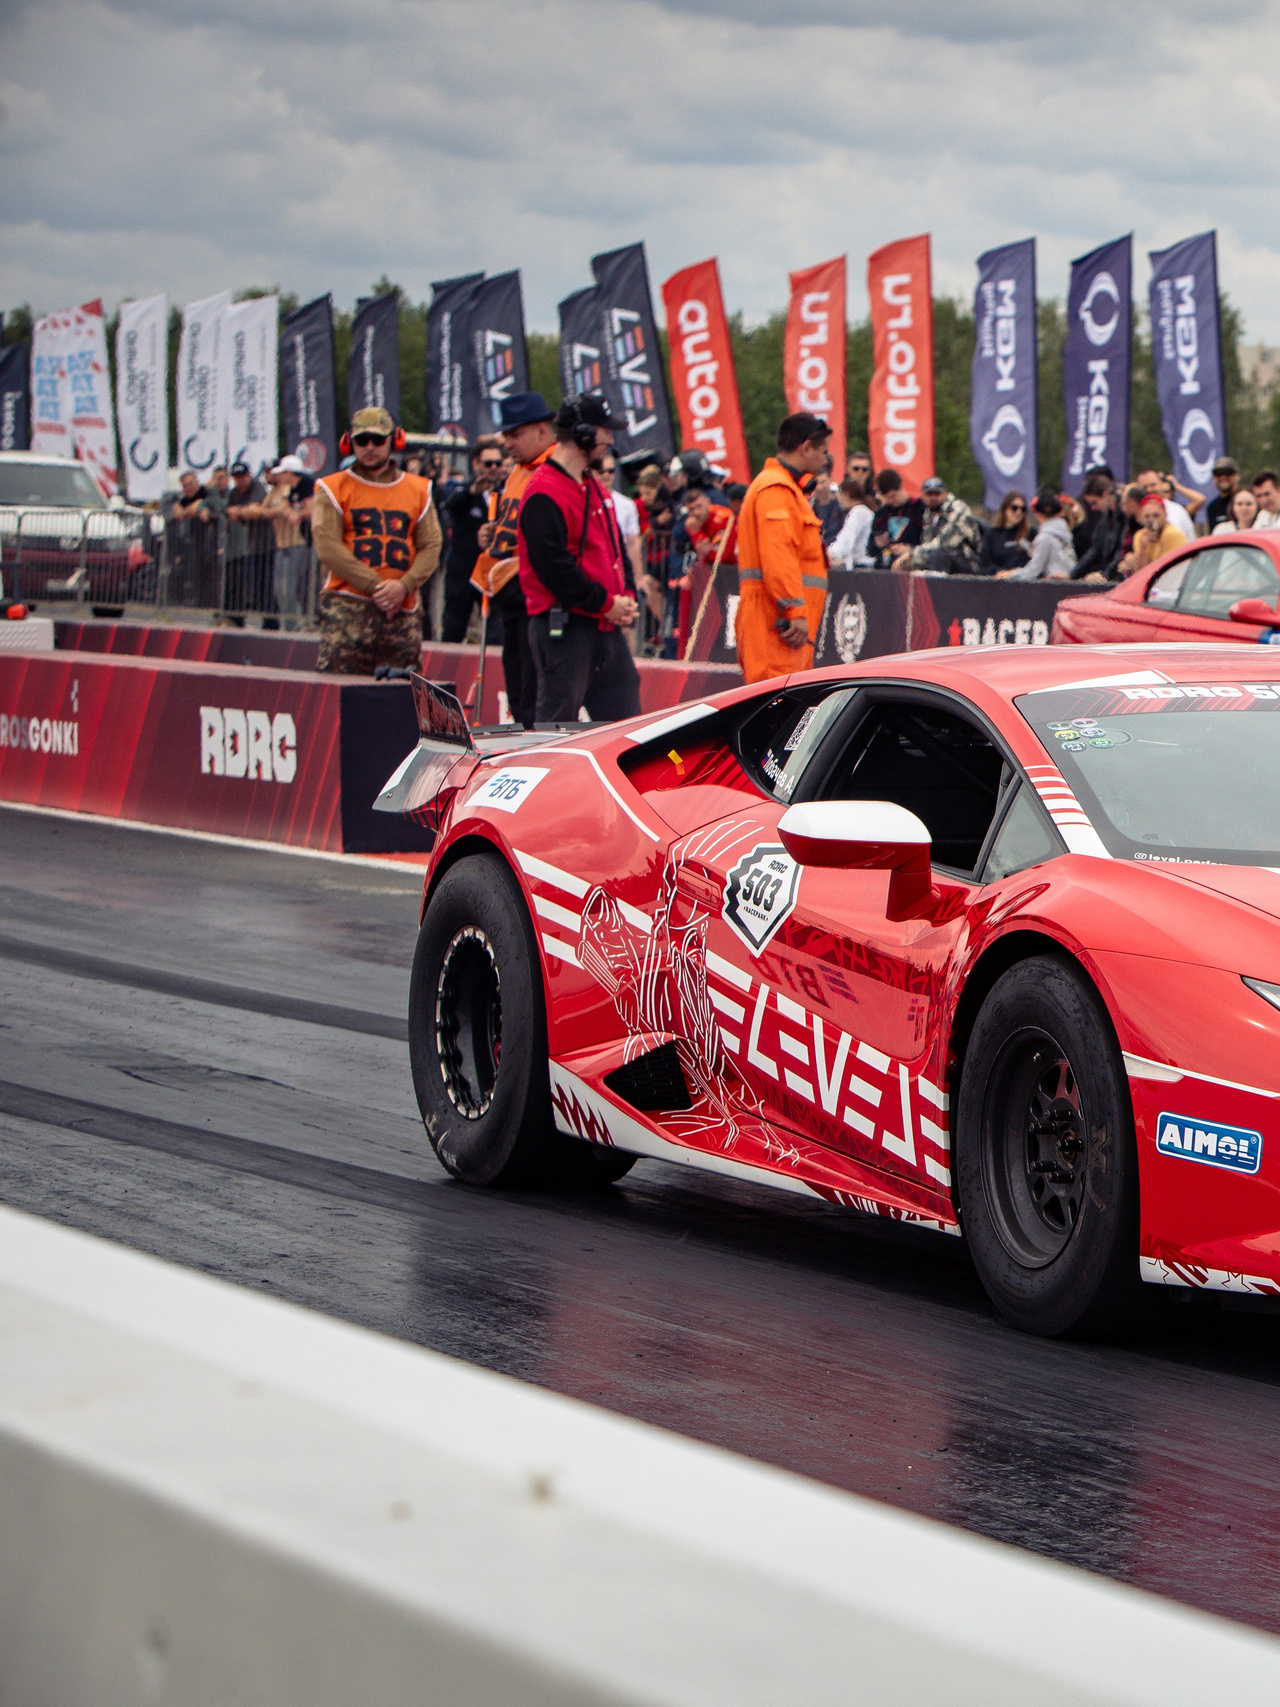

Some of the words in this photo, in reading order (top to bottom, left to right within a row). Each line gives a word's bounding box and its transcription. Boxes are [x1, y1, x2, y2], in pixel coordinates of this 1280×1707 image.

[1117, 686, 1243, 700] RDRC
[200, 706, 297, 784] RDRC
[488, 778, 528, 800] ВТБ
[767, 859, 789, 874] RDRC
[742, 868, 783, 913] 503
[745, 906, 767, 922] RACEPARK
[1160, 1122, 1255, 1165] AIMOL
